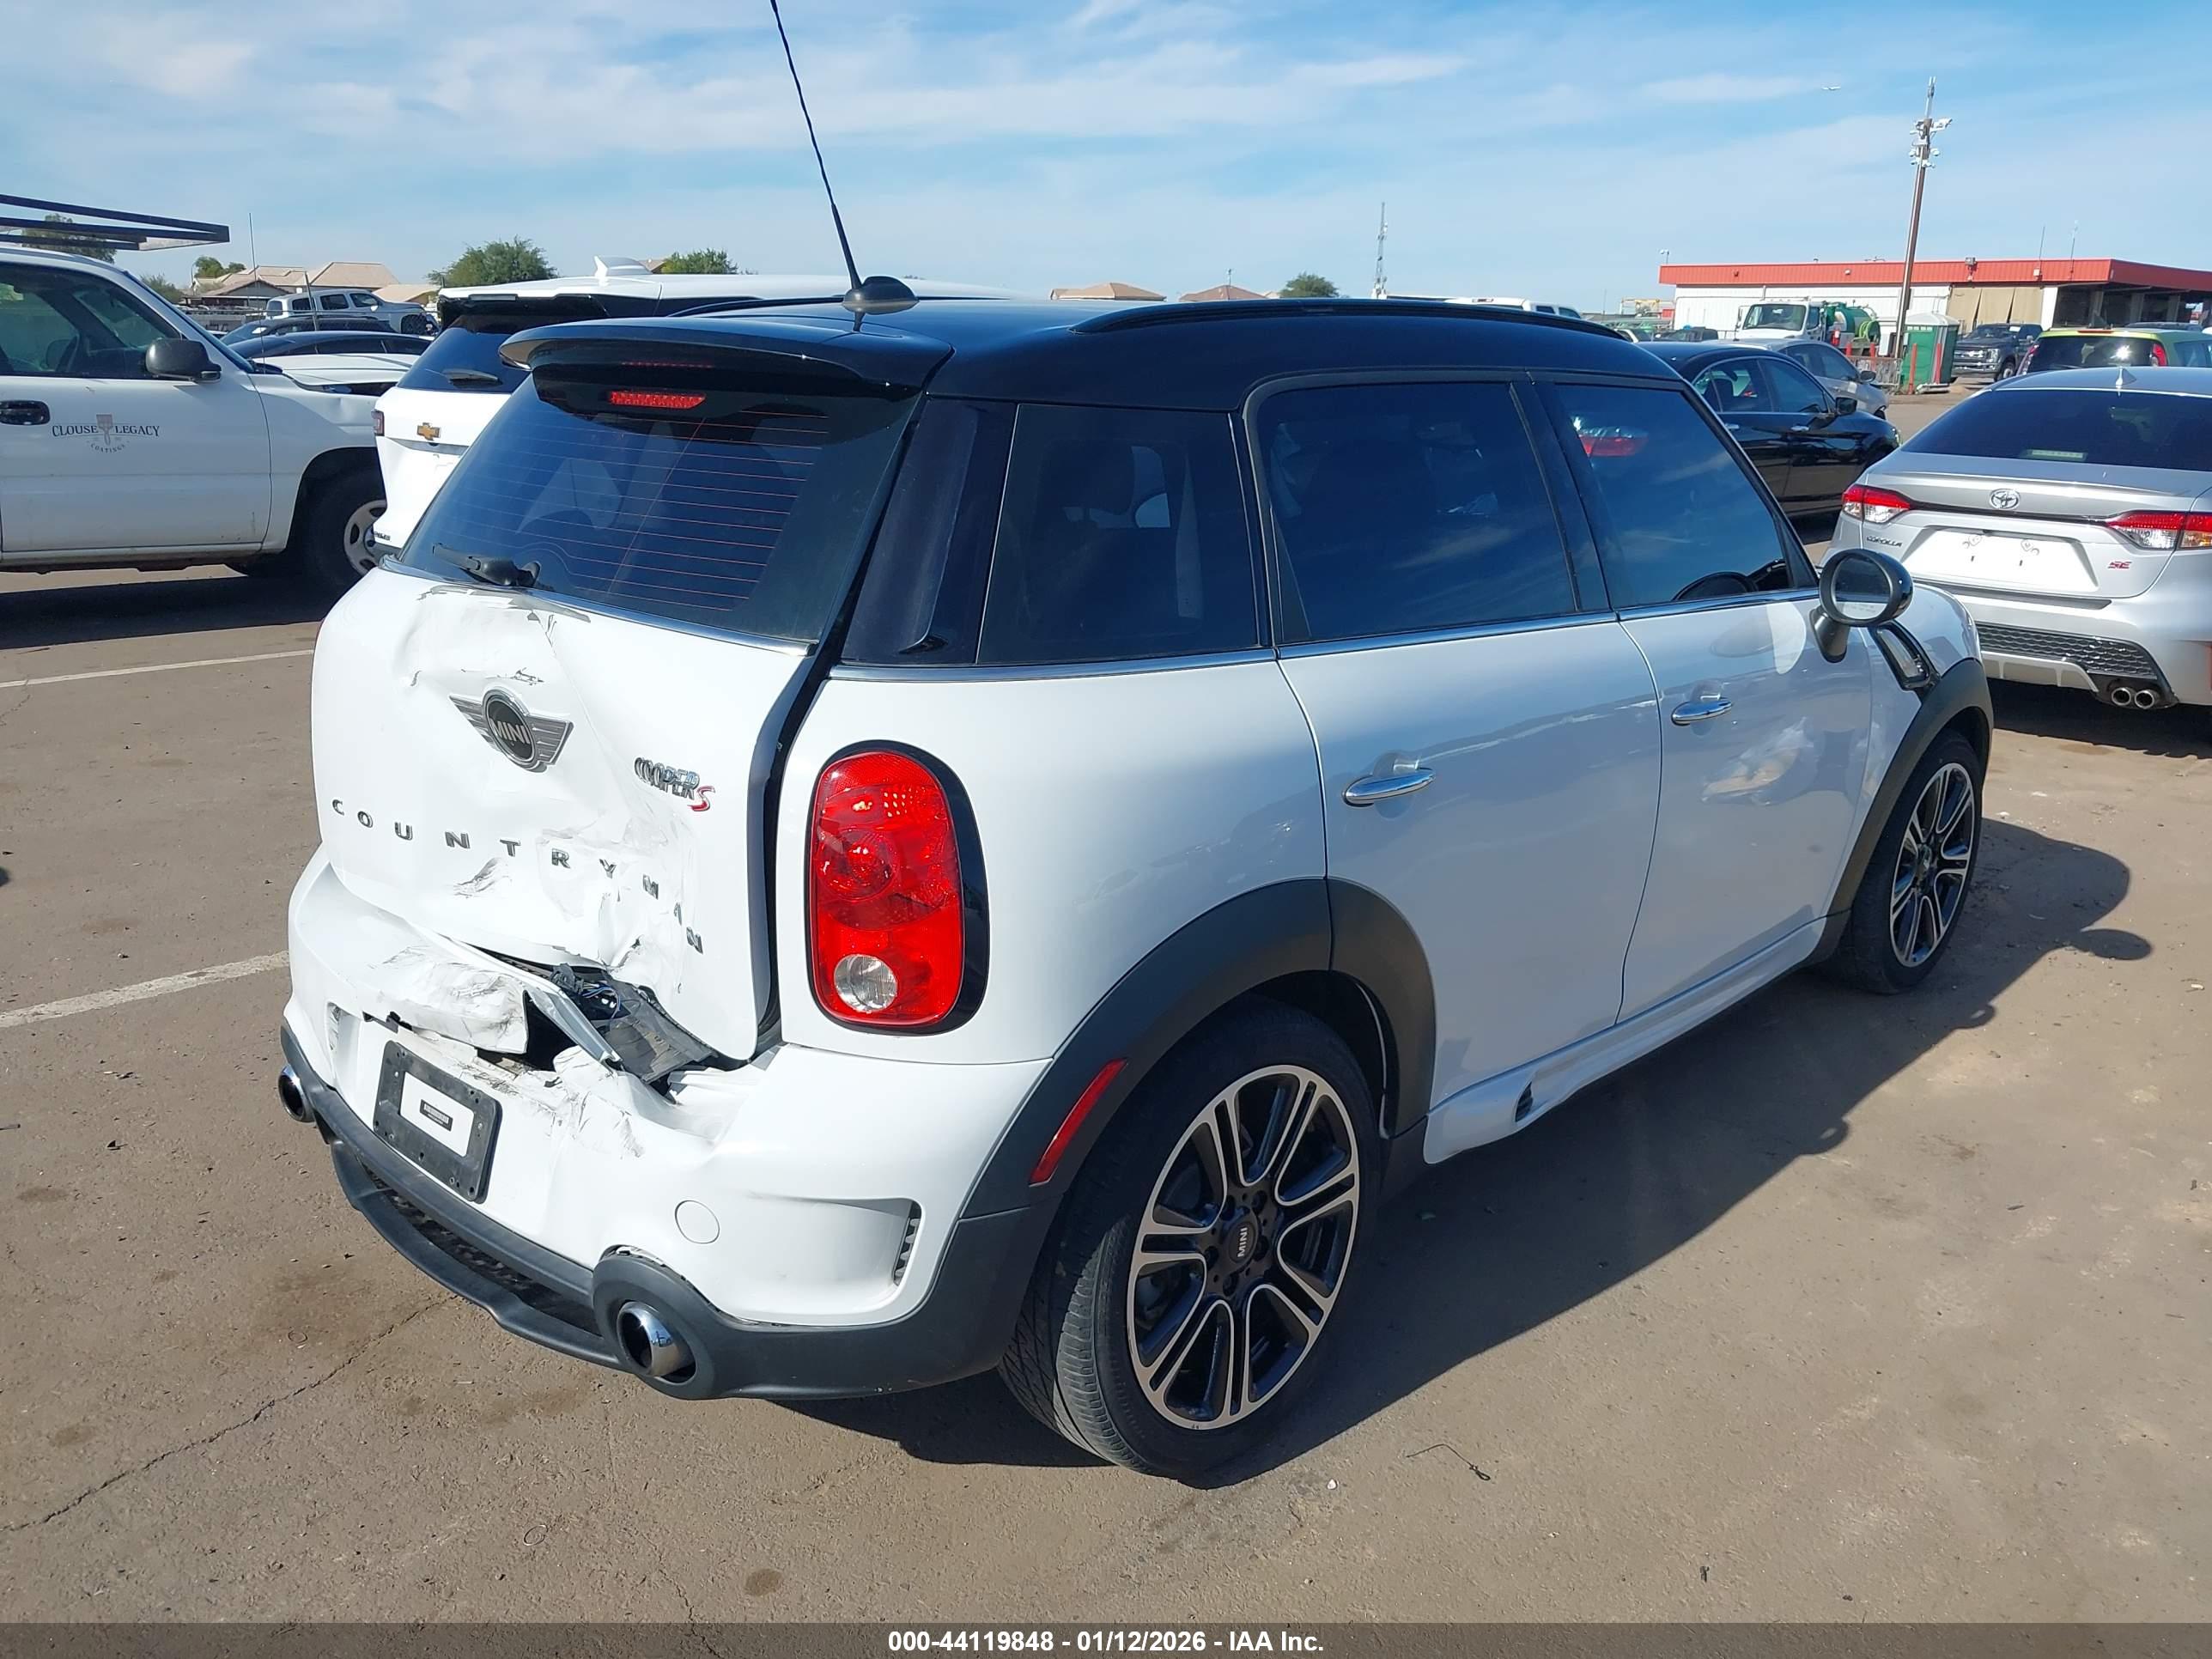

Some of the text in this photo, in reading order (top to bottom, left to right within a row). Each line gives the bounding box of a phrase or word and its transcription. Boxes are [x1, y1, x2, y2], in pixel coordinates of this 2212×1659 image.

[52, 425, 161, 437] CLOUSE LEGACY
[1866, 535, 1903, 548] COROLLA
[488, 716, 532, 745] MINI
[634, 757, 716, 812] COOPER S
[1237, 1227, 1249, 1258] MINI
